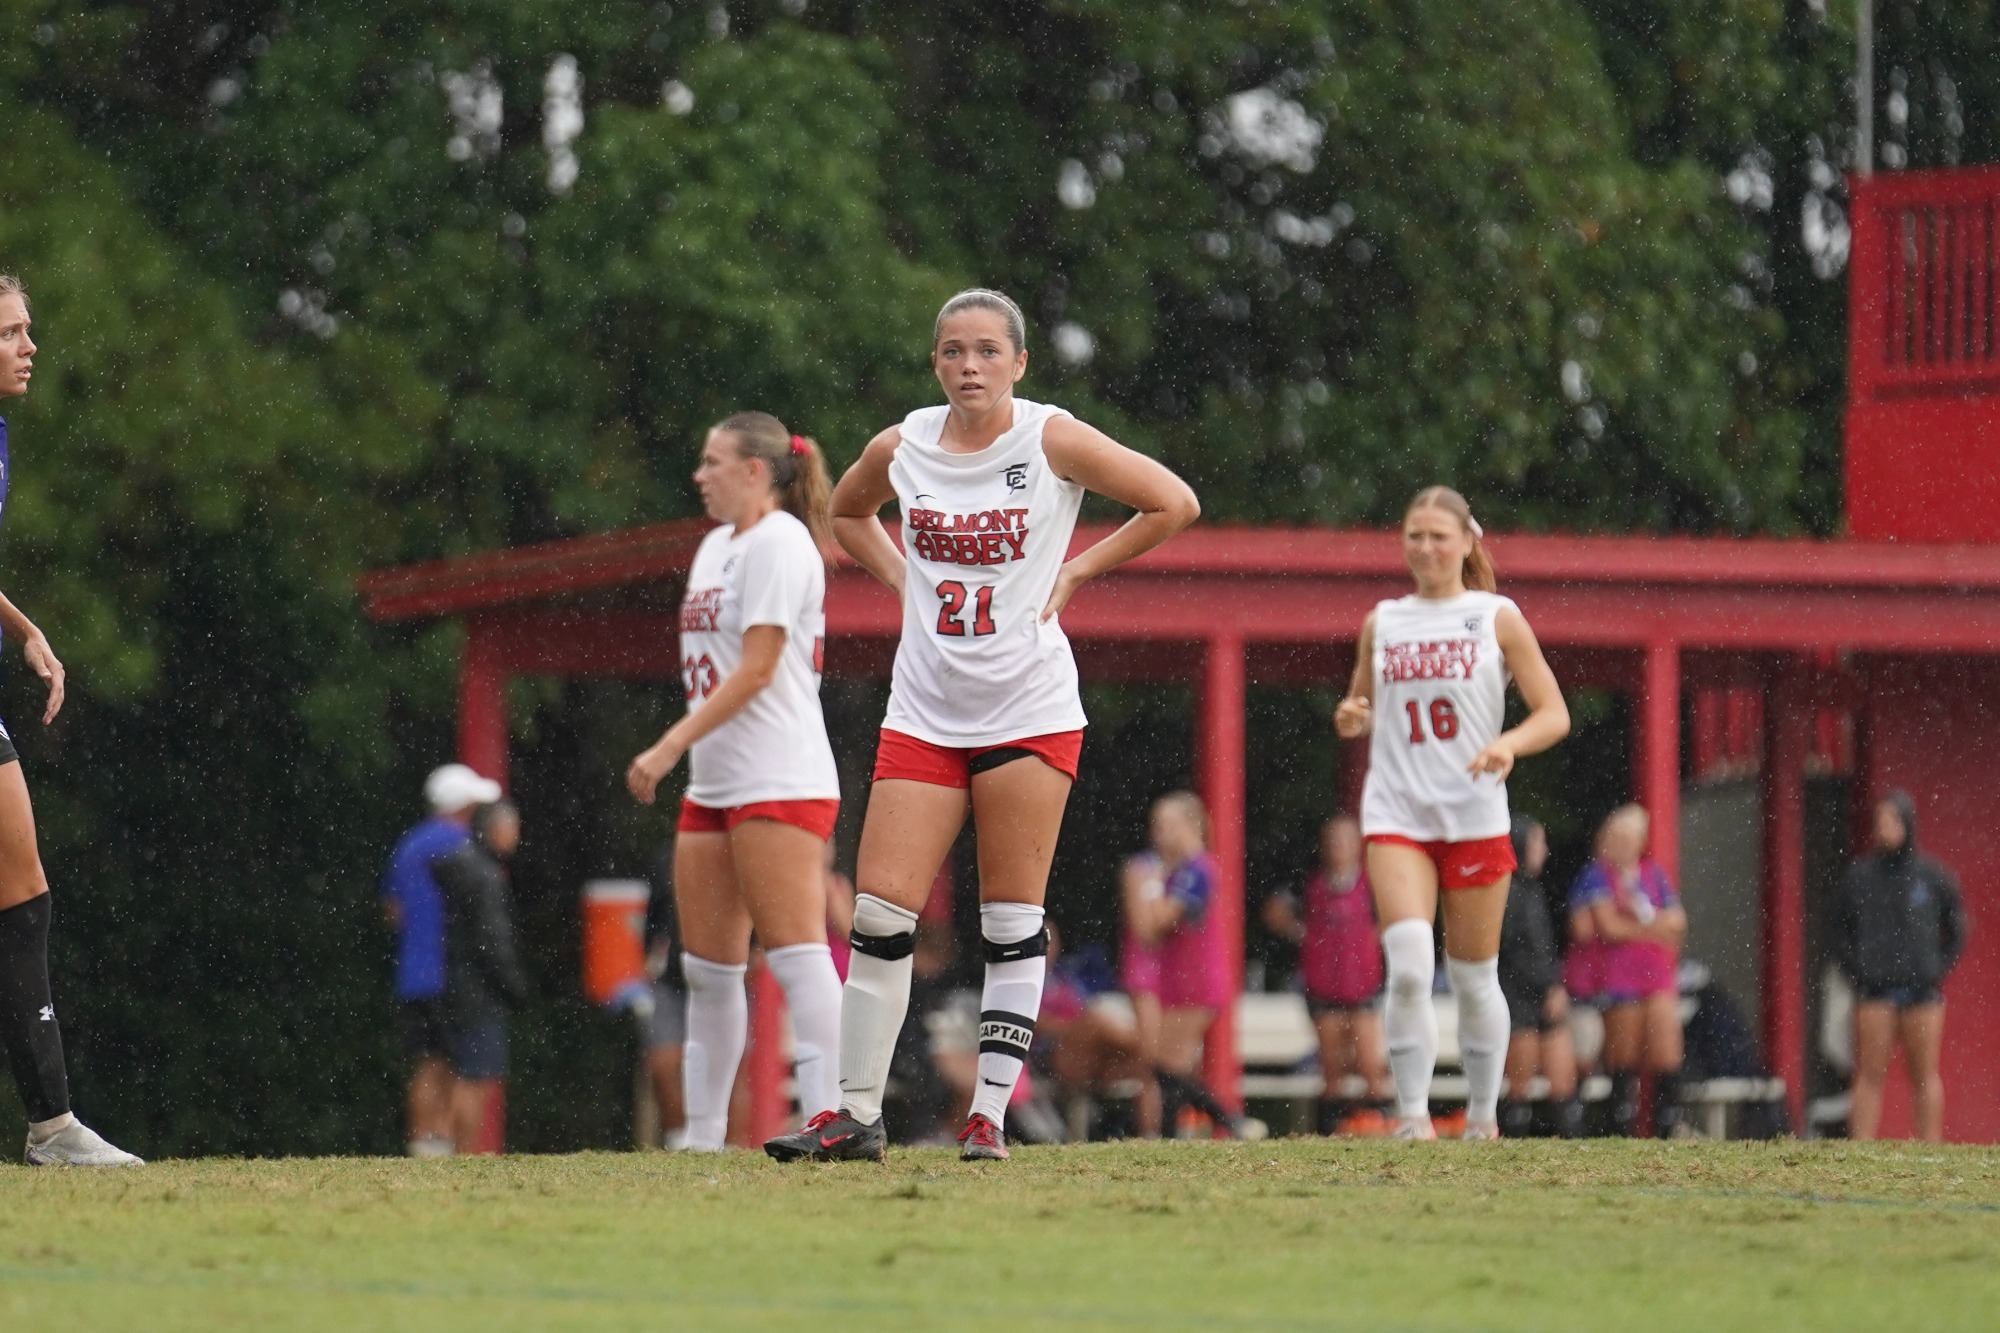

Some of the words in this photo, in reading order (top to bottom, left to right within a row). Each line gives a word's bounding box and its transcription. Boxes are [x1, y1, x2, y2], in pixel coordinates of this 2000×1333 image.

[909, 508, 1029, 533] BELMONT
[914, 529, 1029, 566] ABBEY
[679, 607, 721, 632] BBEY
[935, 579, 997, 637] 21
[1383, 658, 1476, 684] ABBEY
[1405, 697, 1460, 744] 16
